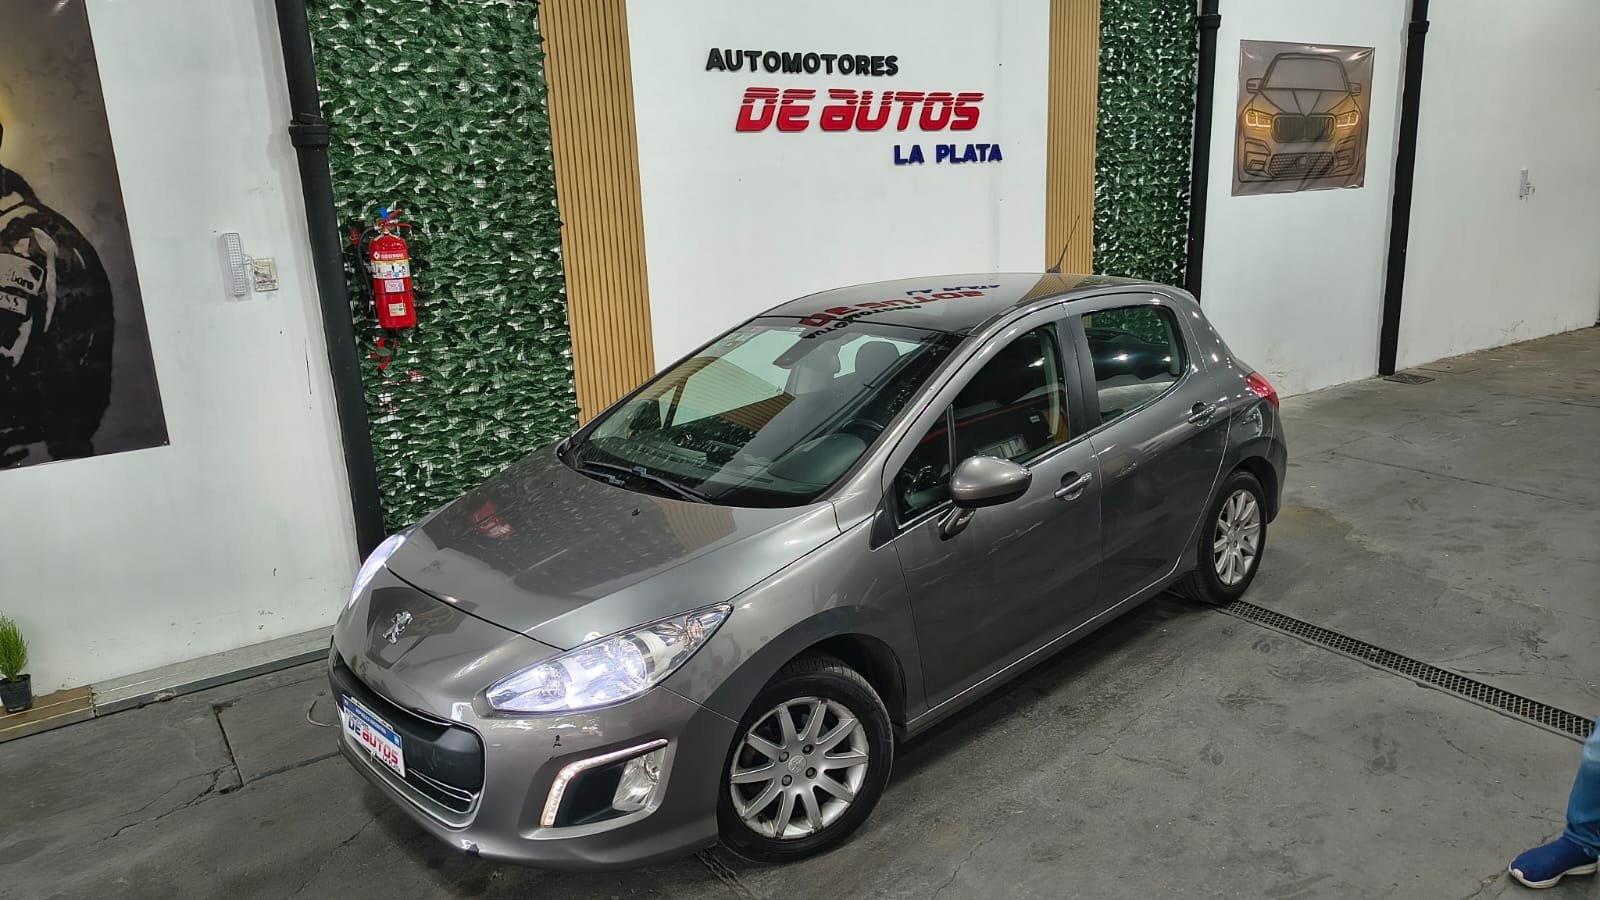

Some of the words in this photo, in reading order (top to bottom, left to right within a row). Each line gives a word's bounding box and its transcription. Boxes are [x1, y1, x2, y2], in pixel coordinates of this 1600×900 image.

[705, 48, 898, 77] AUTOMOTORES
[736, 87, 816, 132] DE
[894, 145, 925, 166] LA
[936, 144, 1002, 164] PLATA
